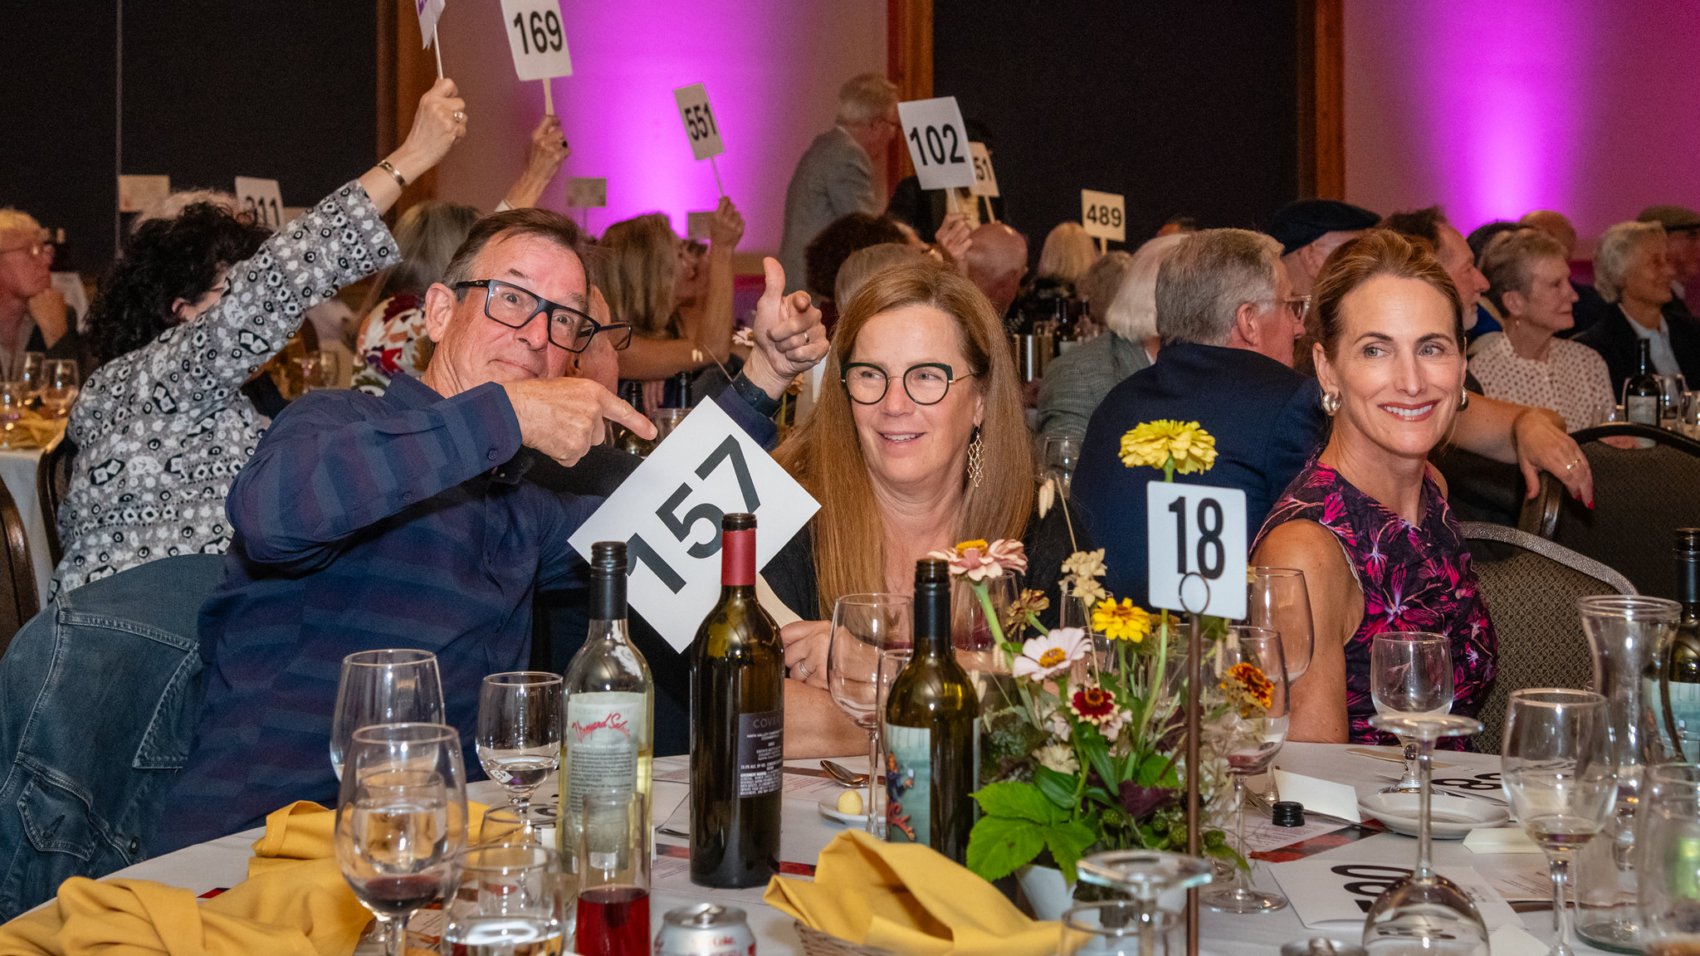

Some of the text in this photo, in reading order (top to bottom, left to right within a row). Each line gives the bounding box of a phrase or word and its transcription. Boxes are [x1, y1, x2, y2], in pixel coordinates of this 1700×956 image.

[513, 10, 563, 55] 169
[684, 103, 717, 142] 551
[909, 123, 966, 167] 102
[1086, 204, 1124, 229] 489
[626, 433, 761, 595] 157
[1168, 496, 1226, 581] 18
